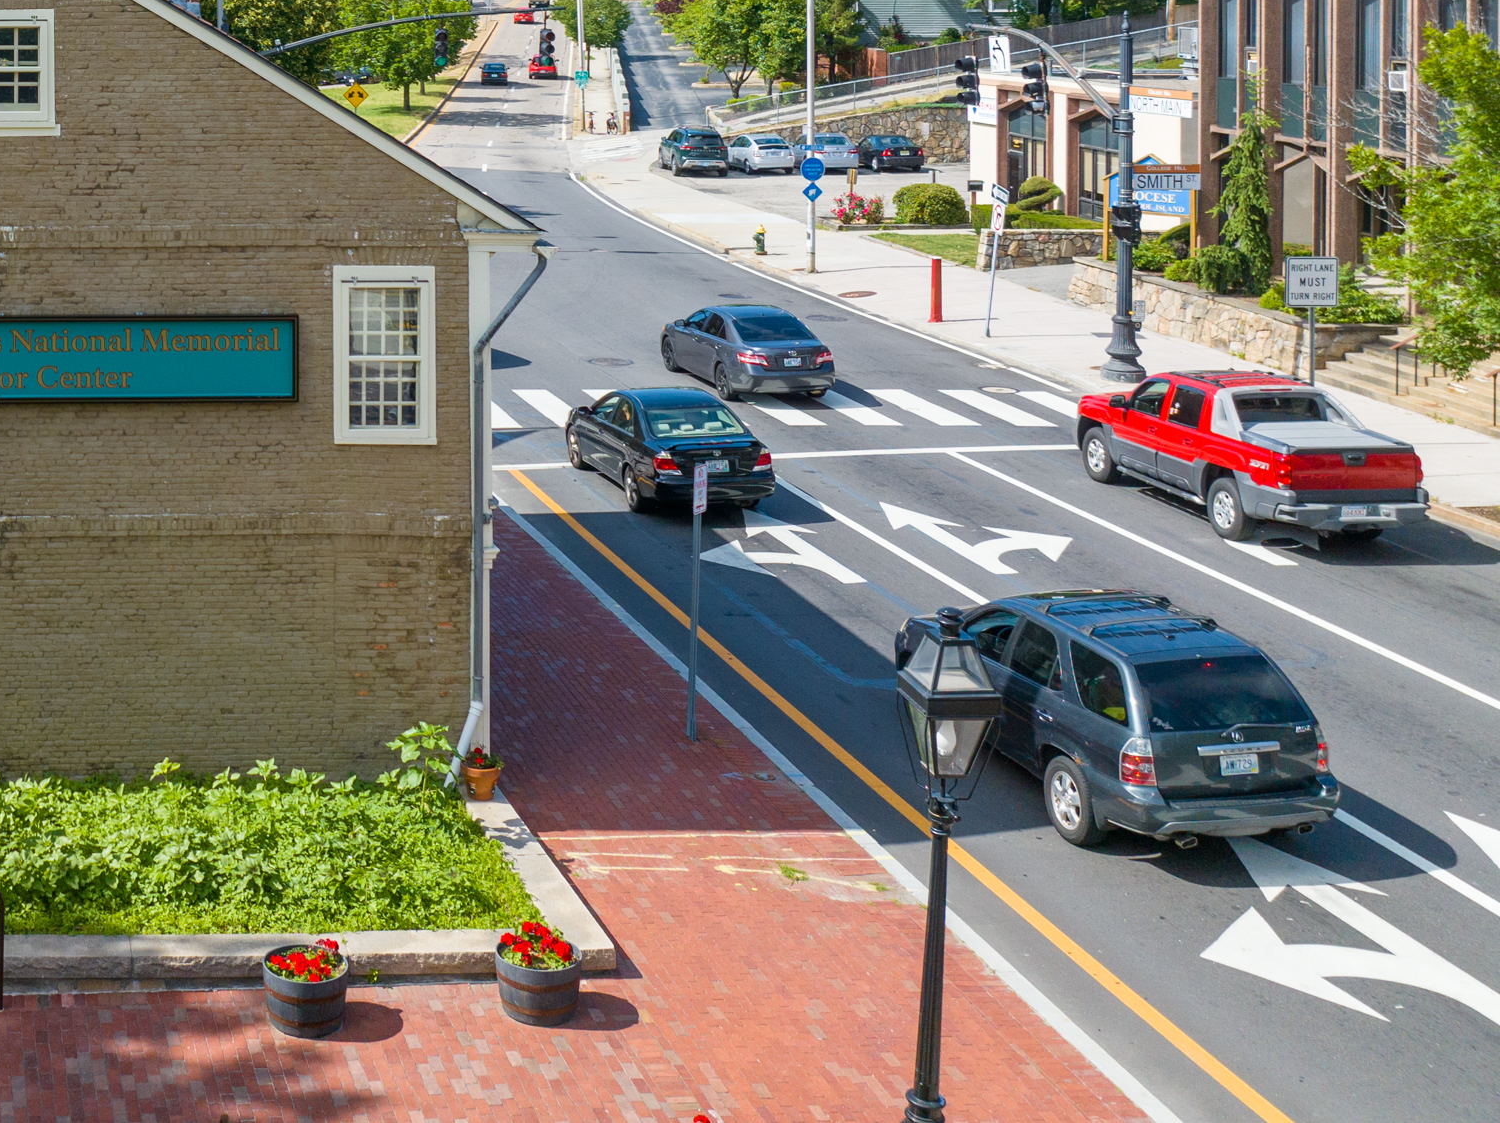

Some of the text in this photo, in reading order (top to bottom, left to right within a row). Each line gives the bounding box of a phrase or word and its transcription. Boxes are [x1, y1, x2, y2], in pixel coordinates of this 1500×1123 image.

[1130, 97, 1159, 112] NORTH
[1161, 99, 1182, 115] MAIN
[1136, 174, 1183, 188] SMITH
[1155, 203, 1185, 213] ISLAND
[1291, 264, 1334, 272] RIGHT LANE
[1300, 278, 1326, 287] MUST
[1291, 292, 1335, 300] TURN RIGHT
[10, 328, 133, 353] National
[140, 327, 281, 352] Memorial
[36, 365, 133, 389] Center
